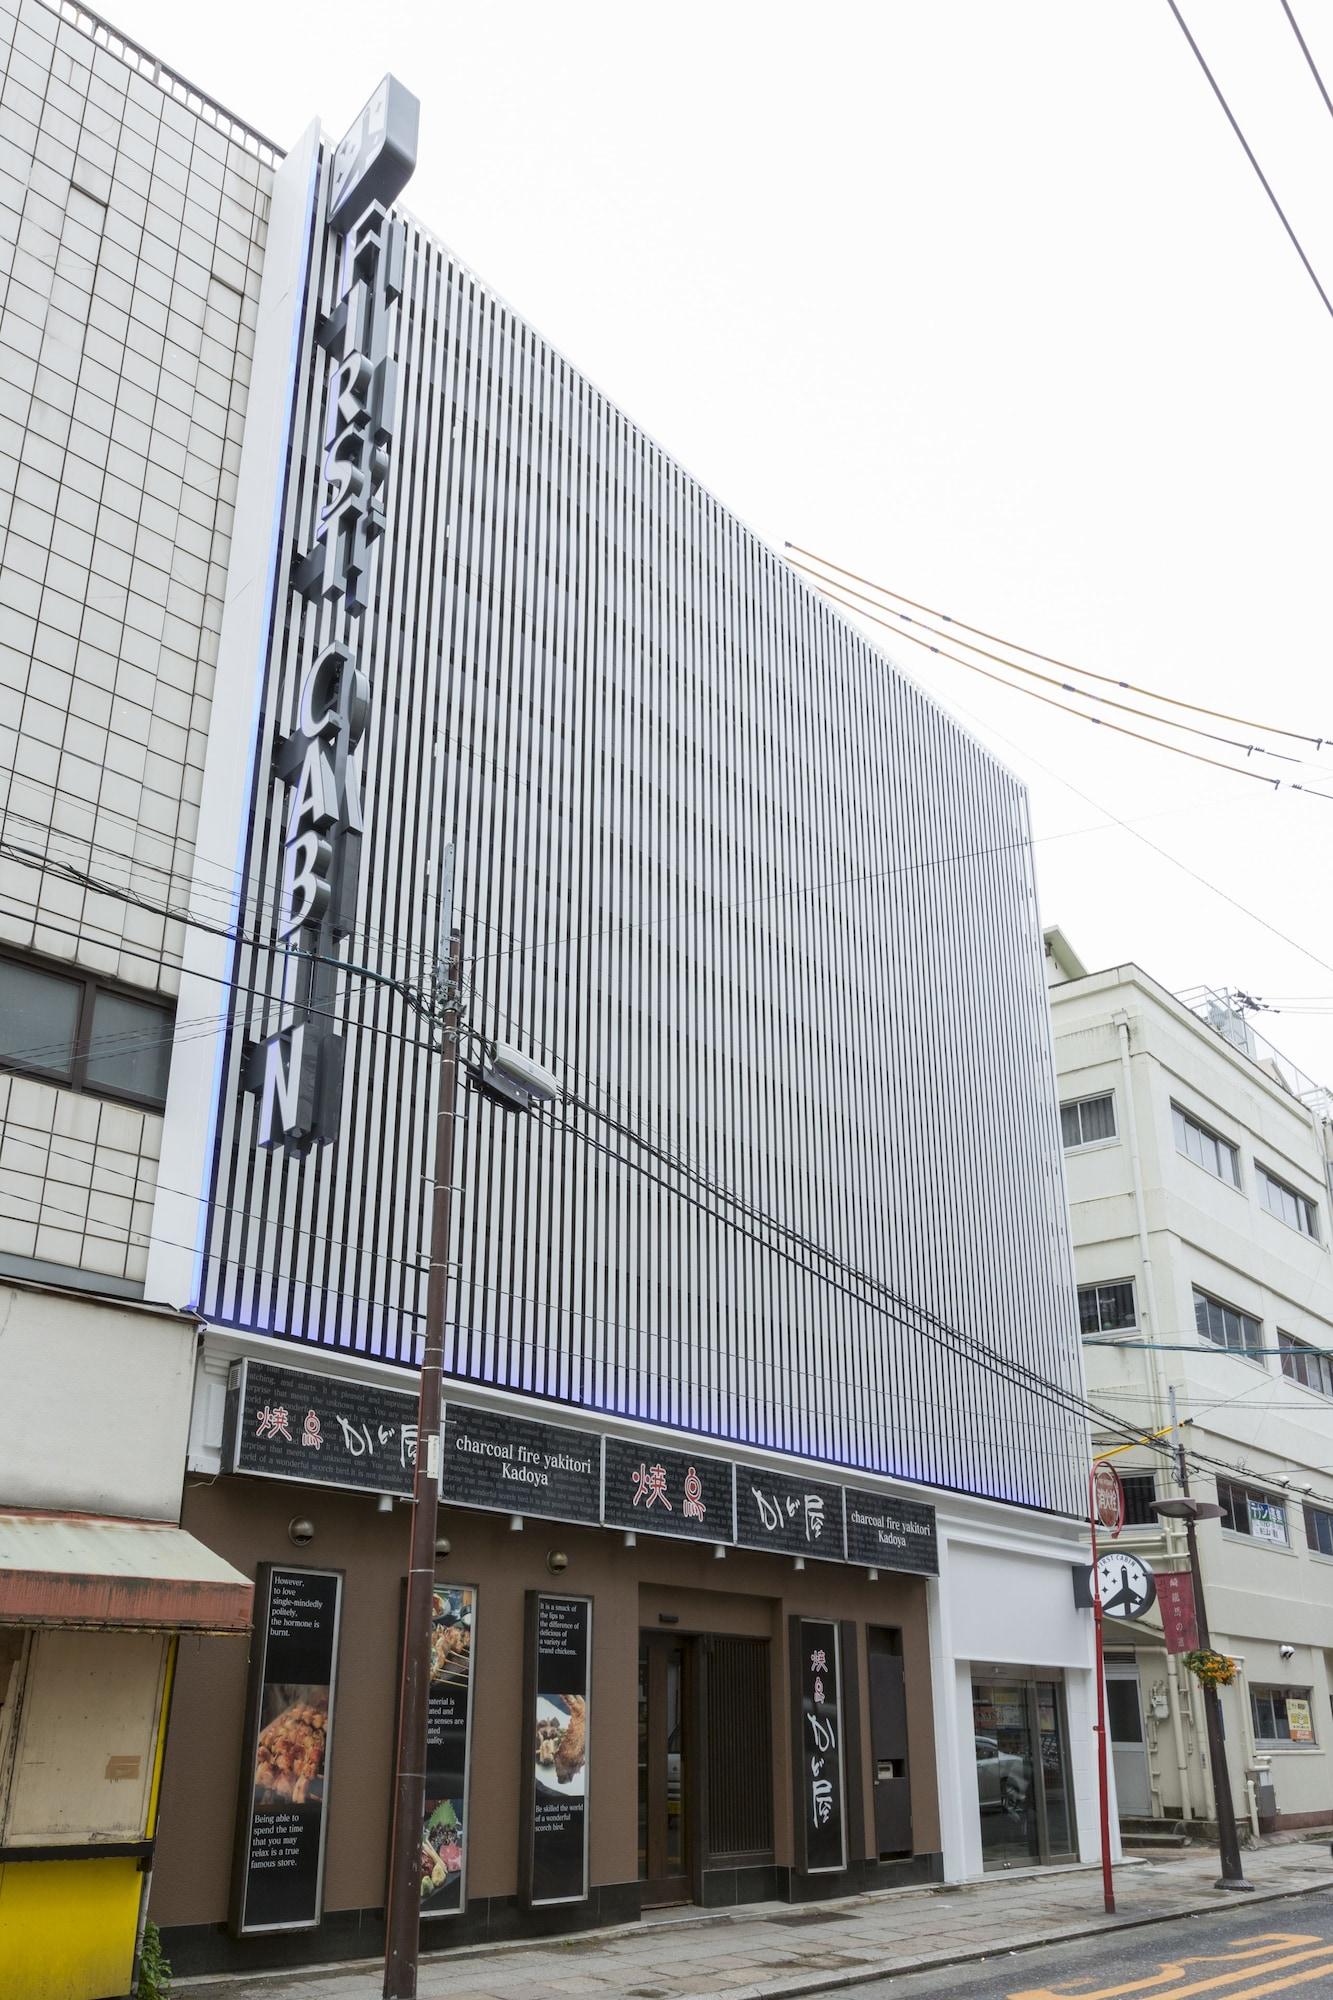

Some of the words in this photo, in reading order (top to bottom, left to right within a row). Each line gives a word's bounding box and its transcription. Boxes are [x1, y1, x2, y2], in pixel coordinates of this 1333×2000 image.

[258, 640, 363, 1150] CABIN
[456, 1435, 513, 1460] charcoal
[518, 1445, 540, 1465] fire
[544, 1453, 591, 1474] yakitori
[502, 1462, 548, 1487] Kadoya
[851, 1511, 885, 1528] charcoal
[886, 1517, 900, 1530] fire
[902, 1522, 931, 1536] yakitori
[878, 1530, 906, 1548] Kadoya
[1116, 1554, 1137, 1568] CABIN
[274, 1576, 305, 1587] However,
[273, 1587, 281, 1595] to
[282, 1587, 296, 1596] love
[272, 1597, 323, 1609] single-mindedly
[271, 1618, 282, 1626] the
[283, 1618, 312, 1628] hormone
[314, 1620, 320, 1628] is
[270, 1628, 290, 1637] burnt.
[426, 1735, 445, 1745] uality.
[255, 1815, 274, 1824] Being
[275, 1813, 291, 1823] able
[253, 1825, 275, 1836] spend
[276, 1824, 287, 1834] the
[289, 1824, 303, 1833] time
[252, 1837, 267, 1846] that
[268, 1838, 281, 1847] you
[283, 1837, 297, 1845] may
[251, 1848, 270, 1858] relax
[270, 1847, 277, 1856] is
[250, 1860, 276, 1869] famous
[277, 1858, 297, 1867] store.
